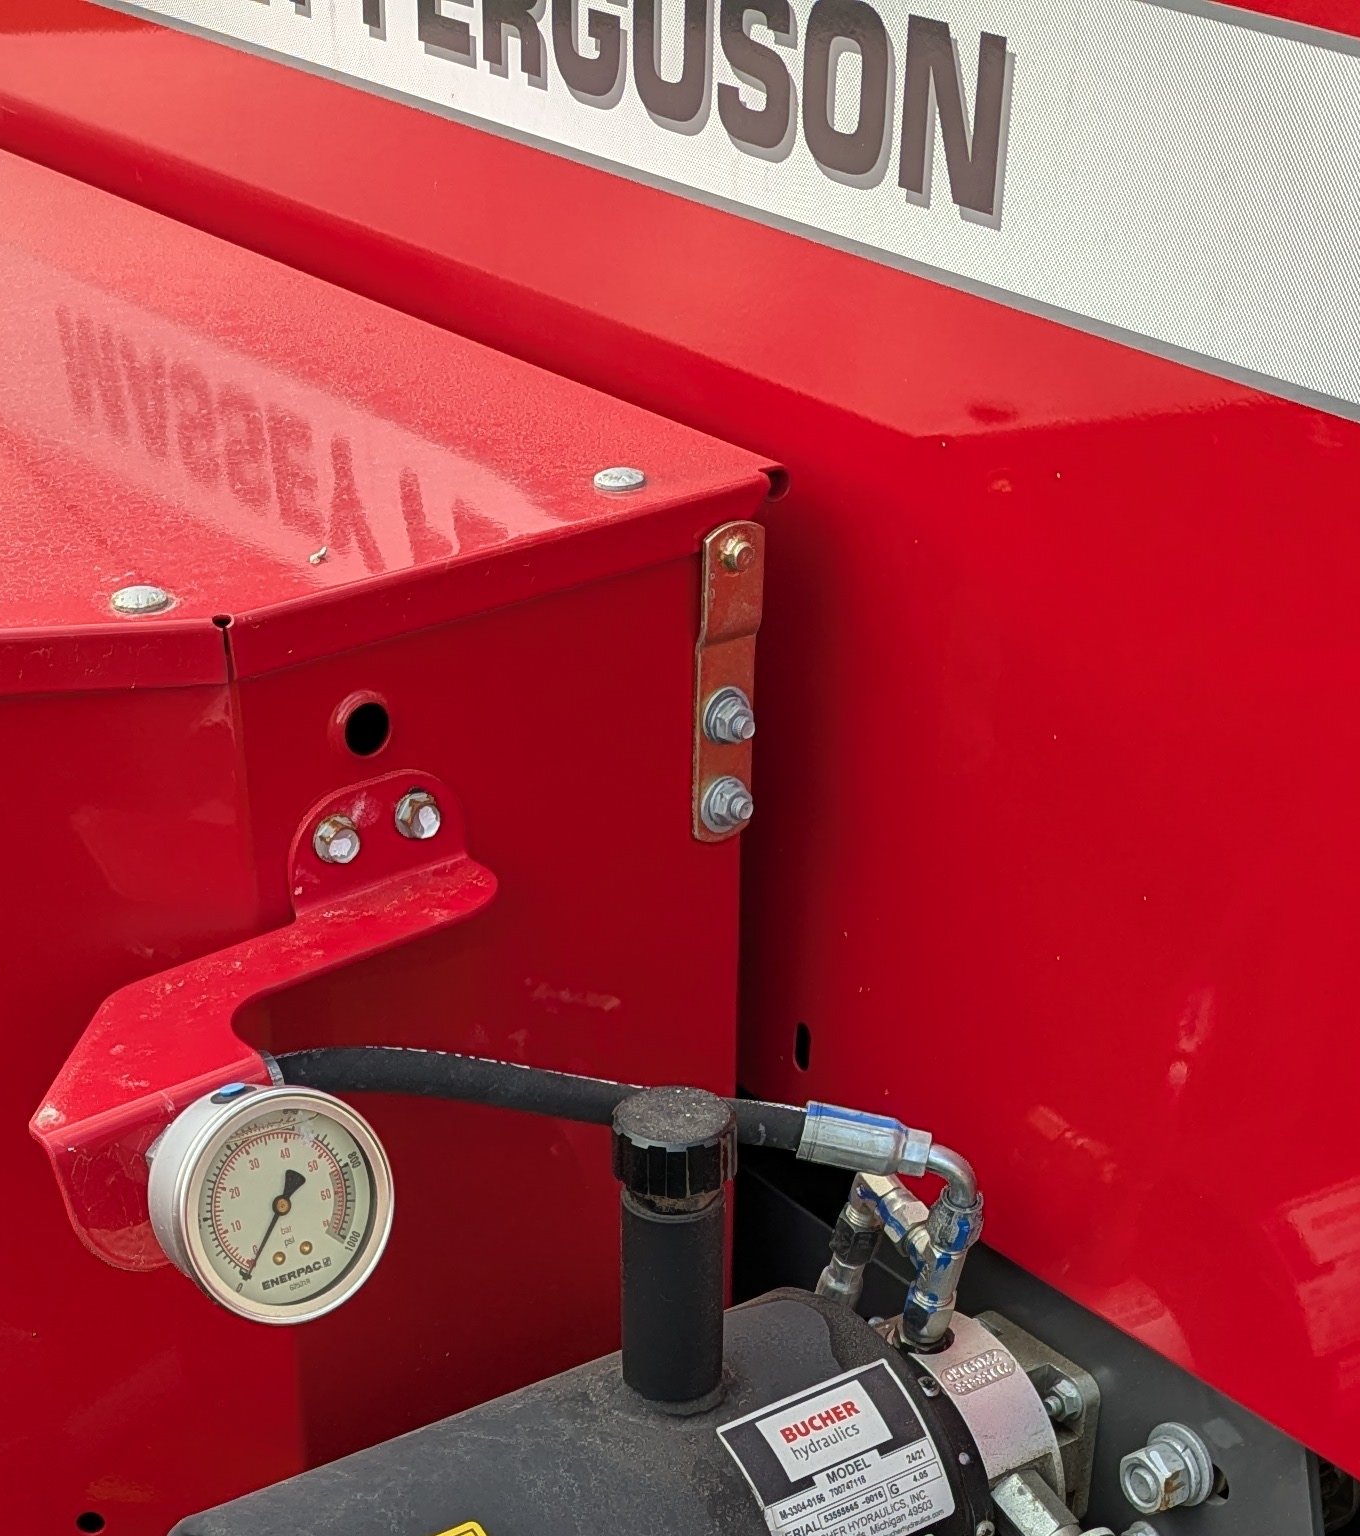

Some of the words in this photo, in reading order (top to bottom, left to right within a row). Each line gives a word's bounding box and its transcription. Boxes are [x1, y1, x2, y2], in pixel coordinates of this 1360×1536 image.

[280, 1147, 290, 1160] 40
[347, 1151, 362, 1169] 800
[248, 1157, 260, 1171] 30
[307, 1159, 319, 1173] 50
[229, 1186, 241, 1199] 20
[320, 1188, 332, 1201] 60
[230, 1219, 242, 1233] 10
[280, 1225, 292, 1235] bar
[284, 1237, 296, 1248] psi
[345, 1230, 361, 1252] 1000
[261, 1260, 323, 1291] ENERPAC
[235, 1283, 244, 1293] 0
[779, 1400, 861, 1444] BUCHER
[790, 1423, 861, 1461] hydraulics
[906, 1448, 926, 1464] 24/21
[826, 1458, 871, 1484] MODEL
[890, 1484, 900, 1495] G
[913, 1470, 929, 1483] 4.05
[848, 1499, 909, 1536] HYDRAULICS,
[909, 1489, 928, 1504] INC.
[908, 1500, 934, 1517] 49503
